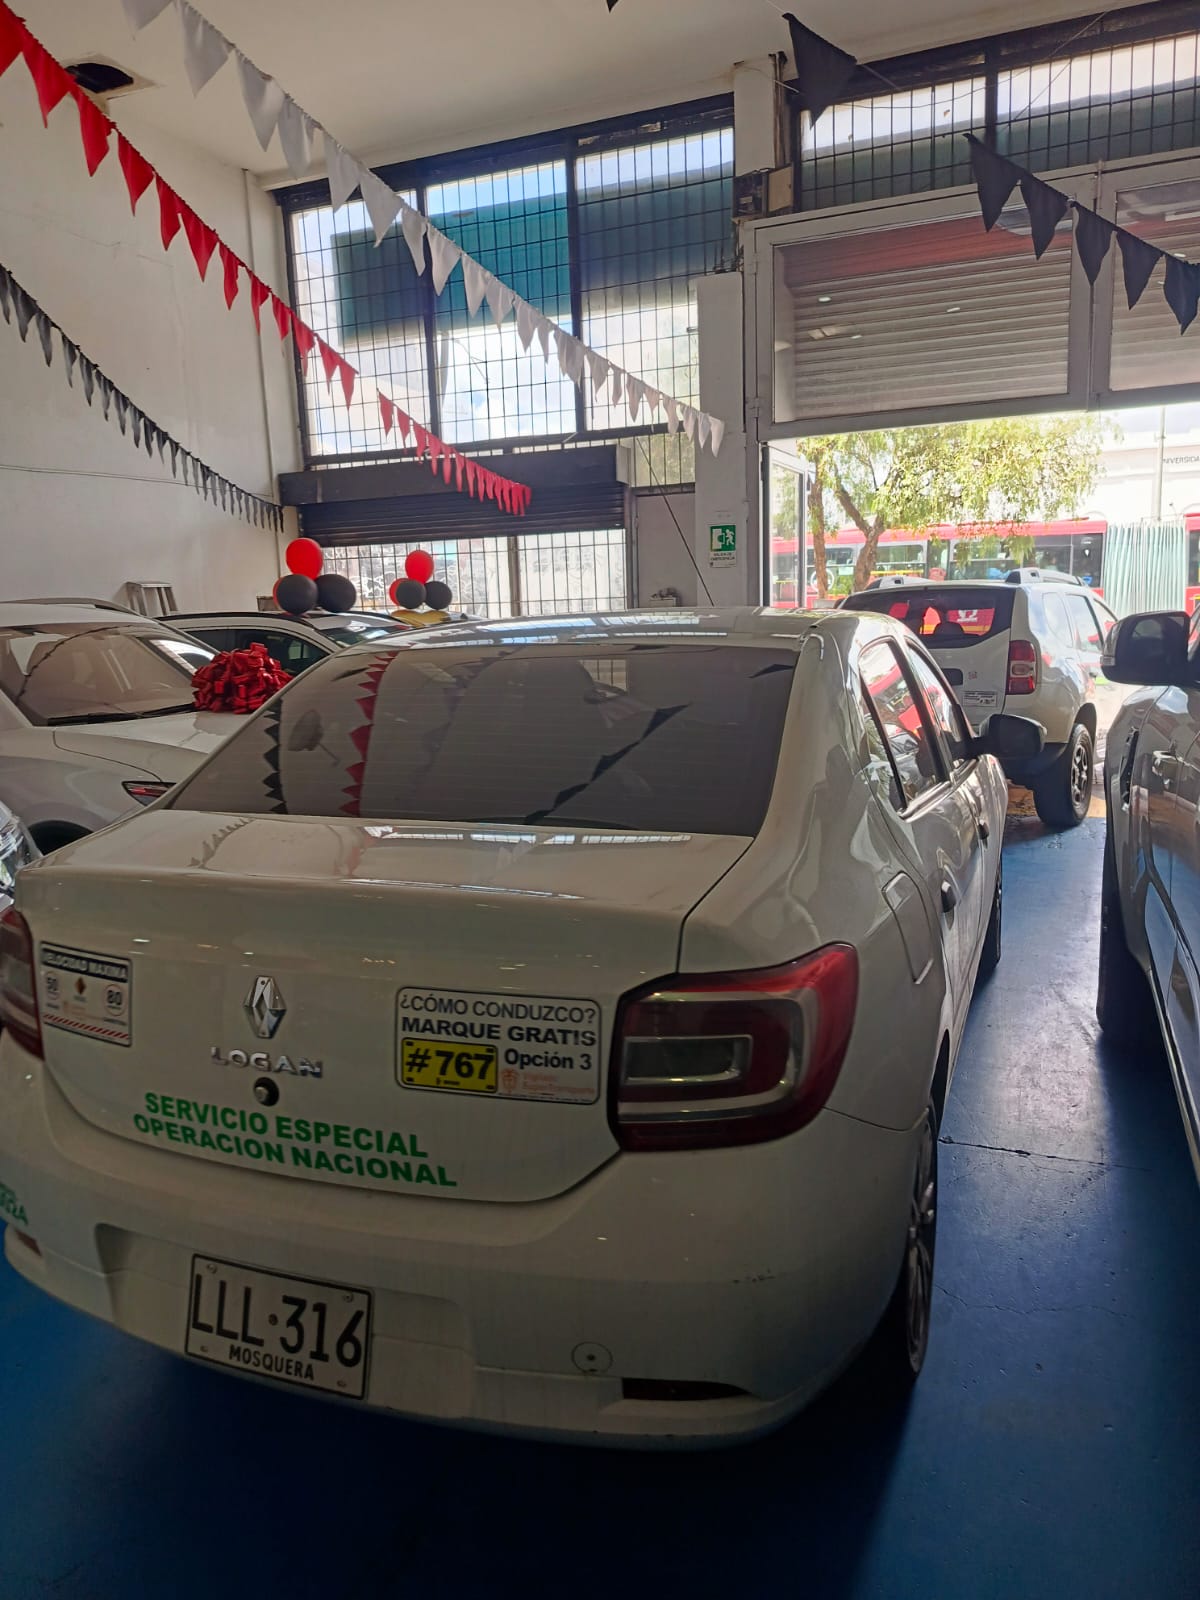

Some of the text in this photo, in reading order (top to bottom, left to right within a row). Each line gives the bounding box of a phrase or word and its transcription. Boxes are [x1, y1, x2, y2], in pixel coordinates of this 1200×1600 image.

[400, 994, 596, 1024] ¿CÓMO CONDUZCO?
[401, 1017, 597, 1047] MARQUE GRATIS
[210, 1046, 323, 1078] LOGAN
[504, 1048, 592, 1071] Opción 3
[145, 1092, 429, 1158] SERVICIO ESPECIAL
[133, 1113, 458, 1187] OPERACION NACIONAL
[229, 1344, 315, 1381] MOSQUERA
